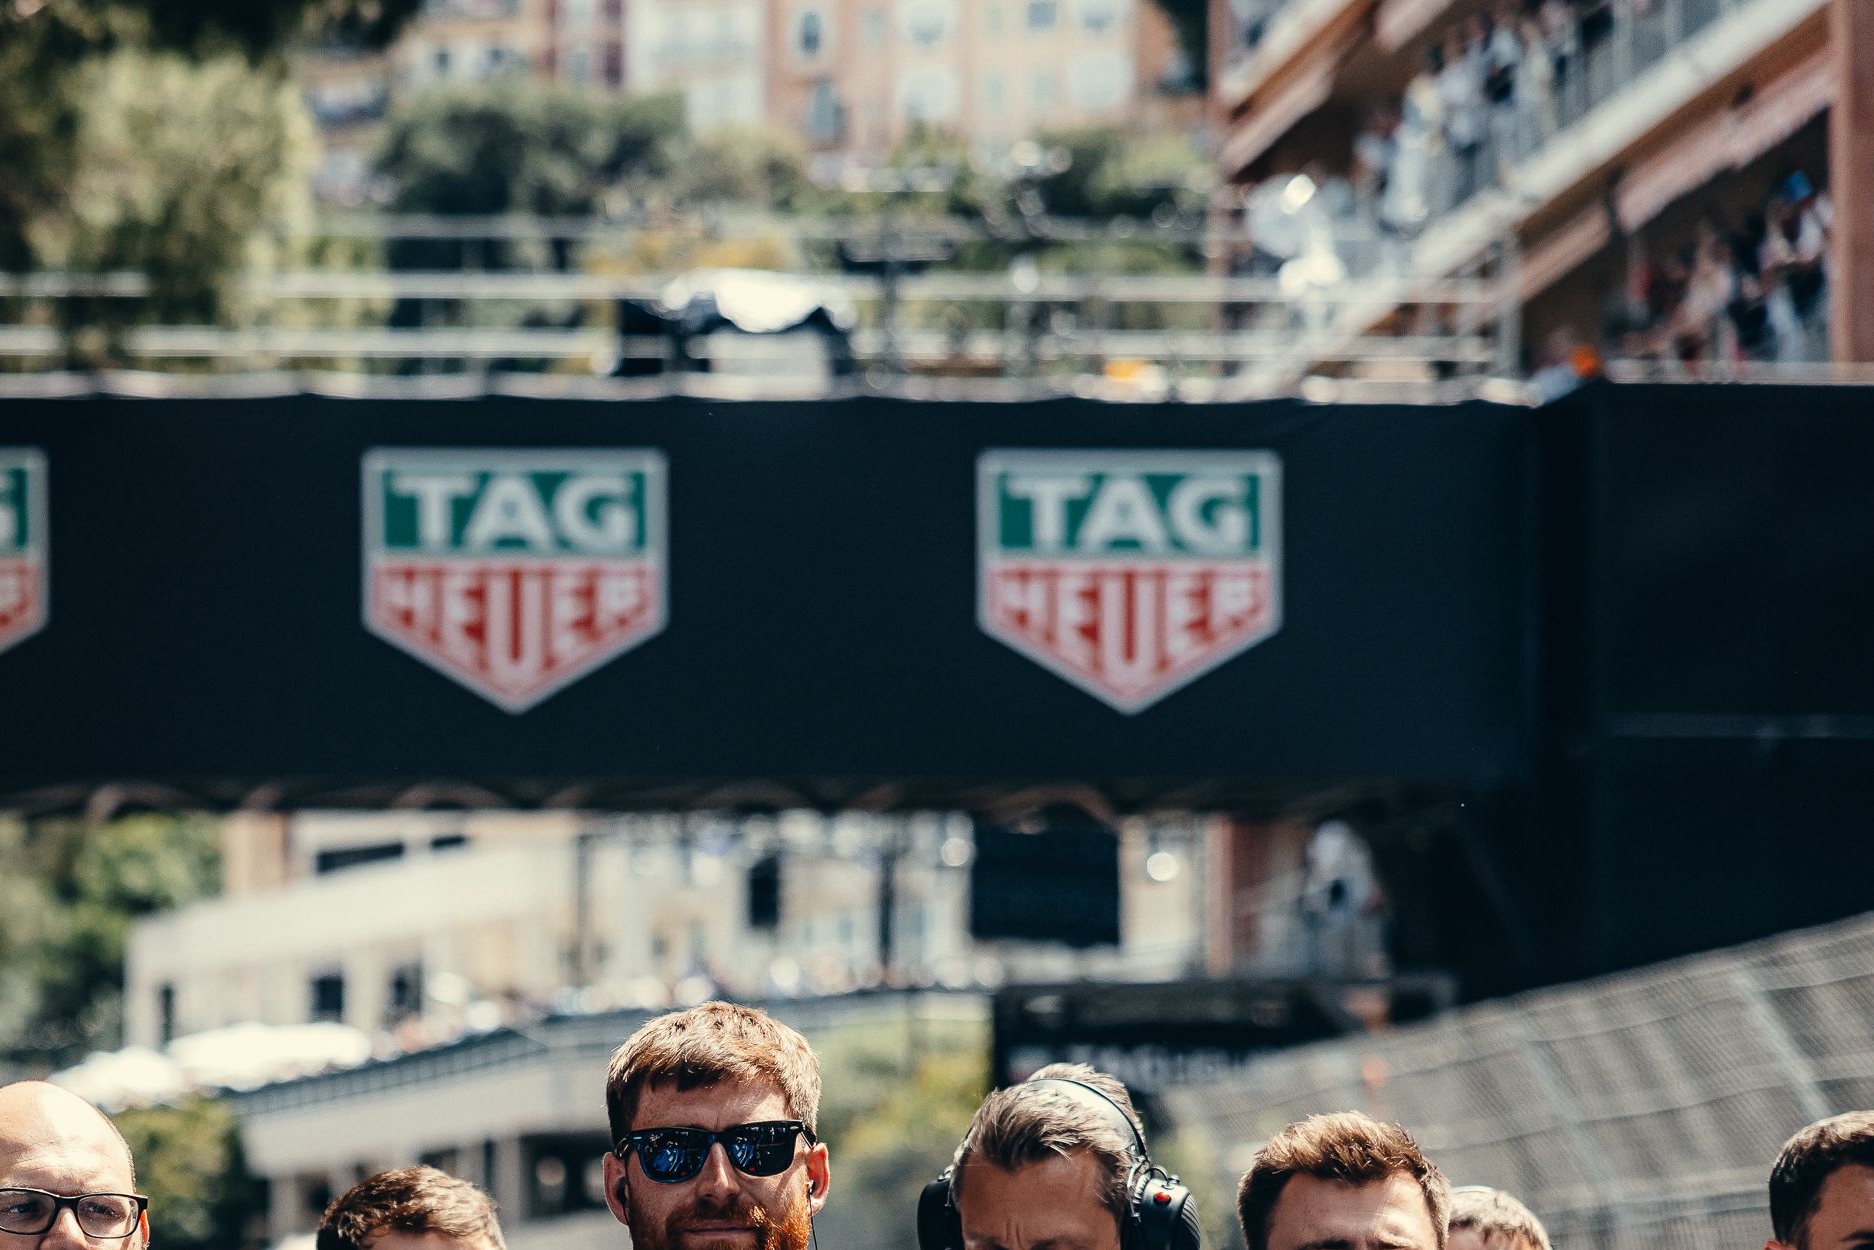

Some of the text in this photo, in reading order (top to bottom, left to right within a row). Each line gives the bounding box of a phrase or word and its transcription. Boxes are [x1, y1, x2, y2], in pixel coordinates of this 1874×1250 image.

[390, 474, 634, 549] TAG
[1007, 476, 1252, 551] TAG
[382, 564, 648, 684] HEUER
[999, 565, 1266, 686] HEUER
